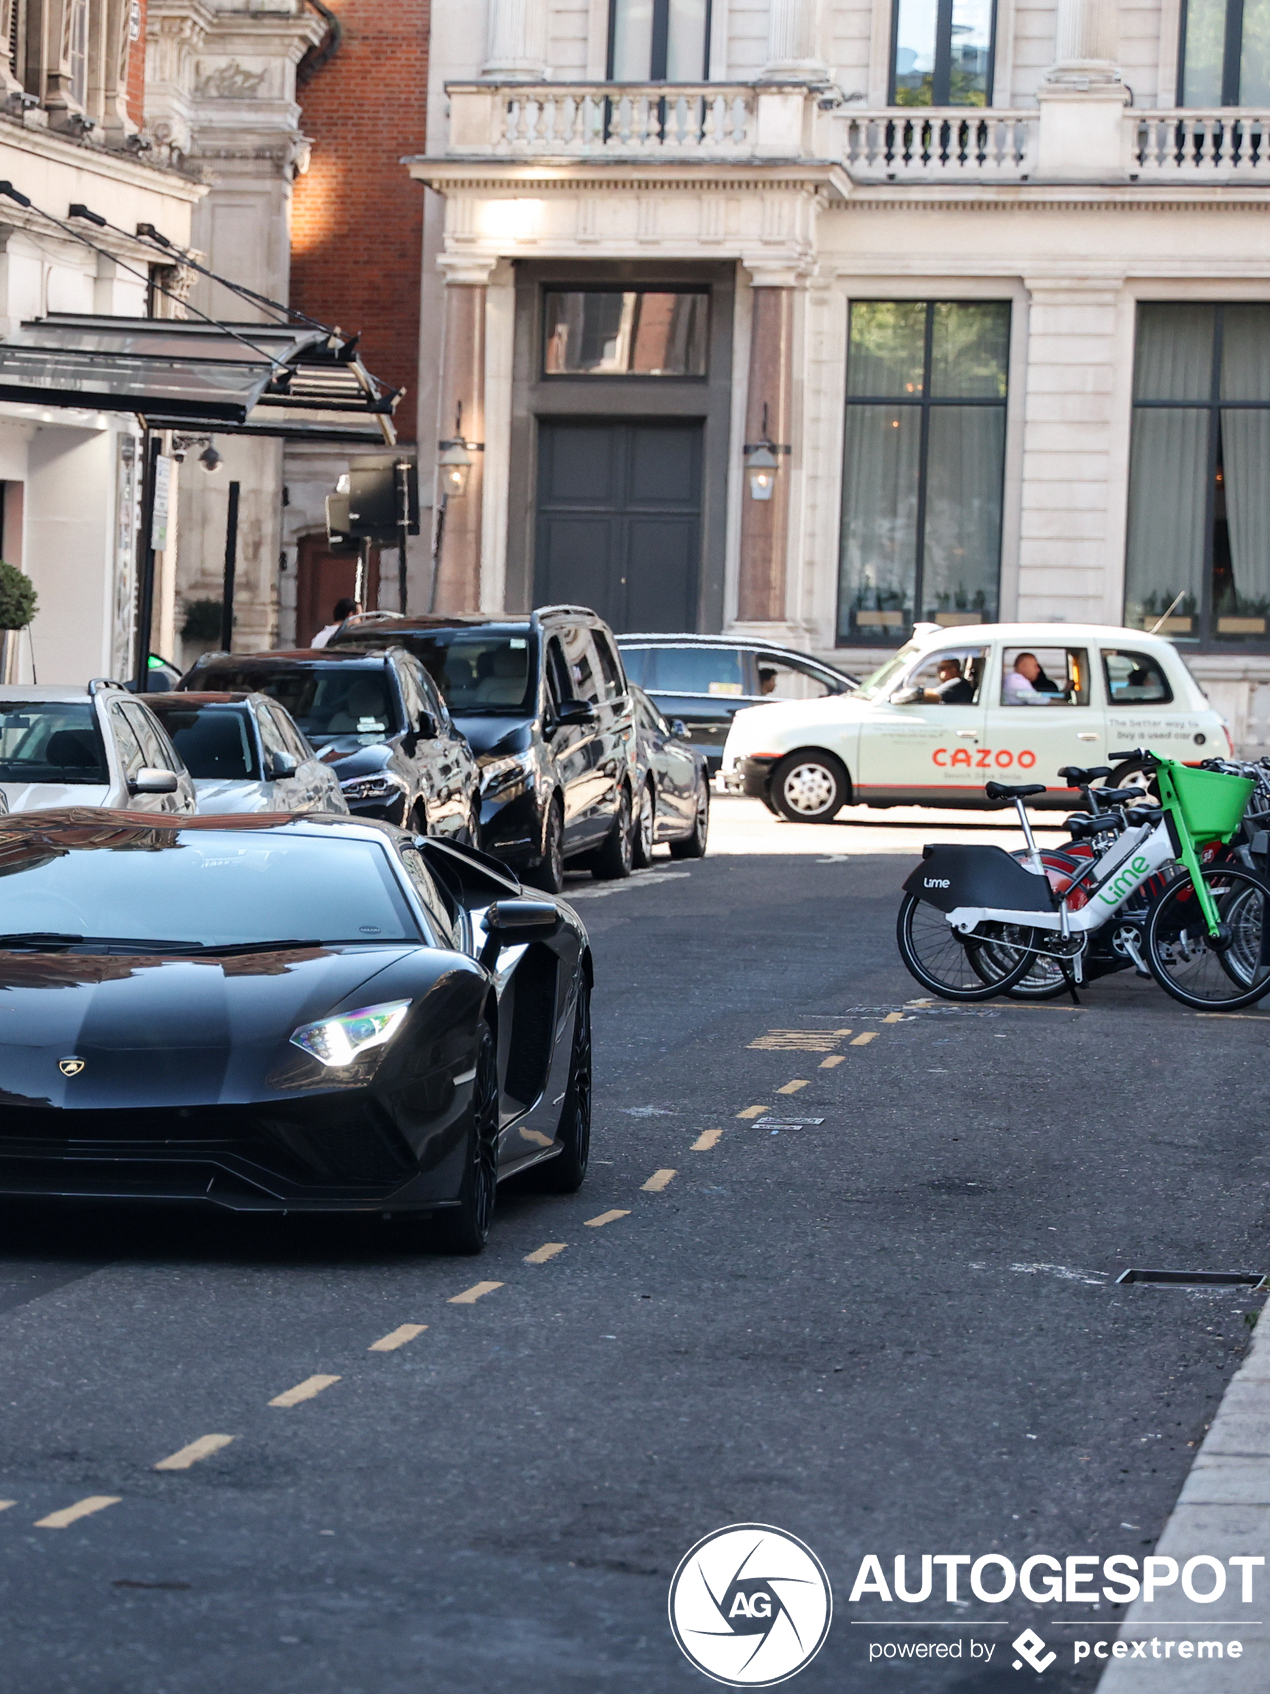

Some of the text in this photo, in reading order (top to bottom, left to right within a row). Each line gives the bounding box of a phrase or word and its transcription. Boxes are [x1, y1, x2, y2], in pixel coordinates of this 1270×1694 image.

[1129, 718, 1161, 728] better
[1164, 720, 1185, 730] way
[1117, 731, 1135, 740] buy
[1147, 731, 1171, 740] used
[1173, 732, 1191, 740] car
[932, 748, 1037, 769] CAZOO
[923, 876, 951, 889] Lime
[1098, 856, 1150, 905] Lime
